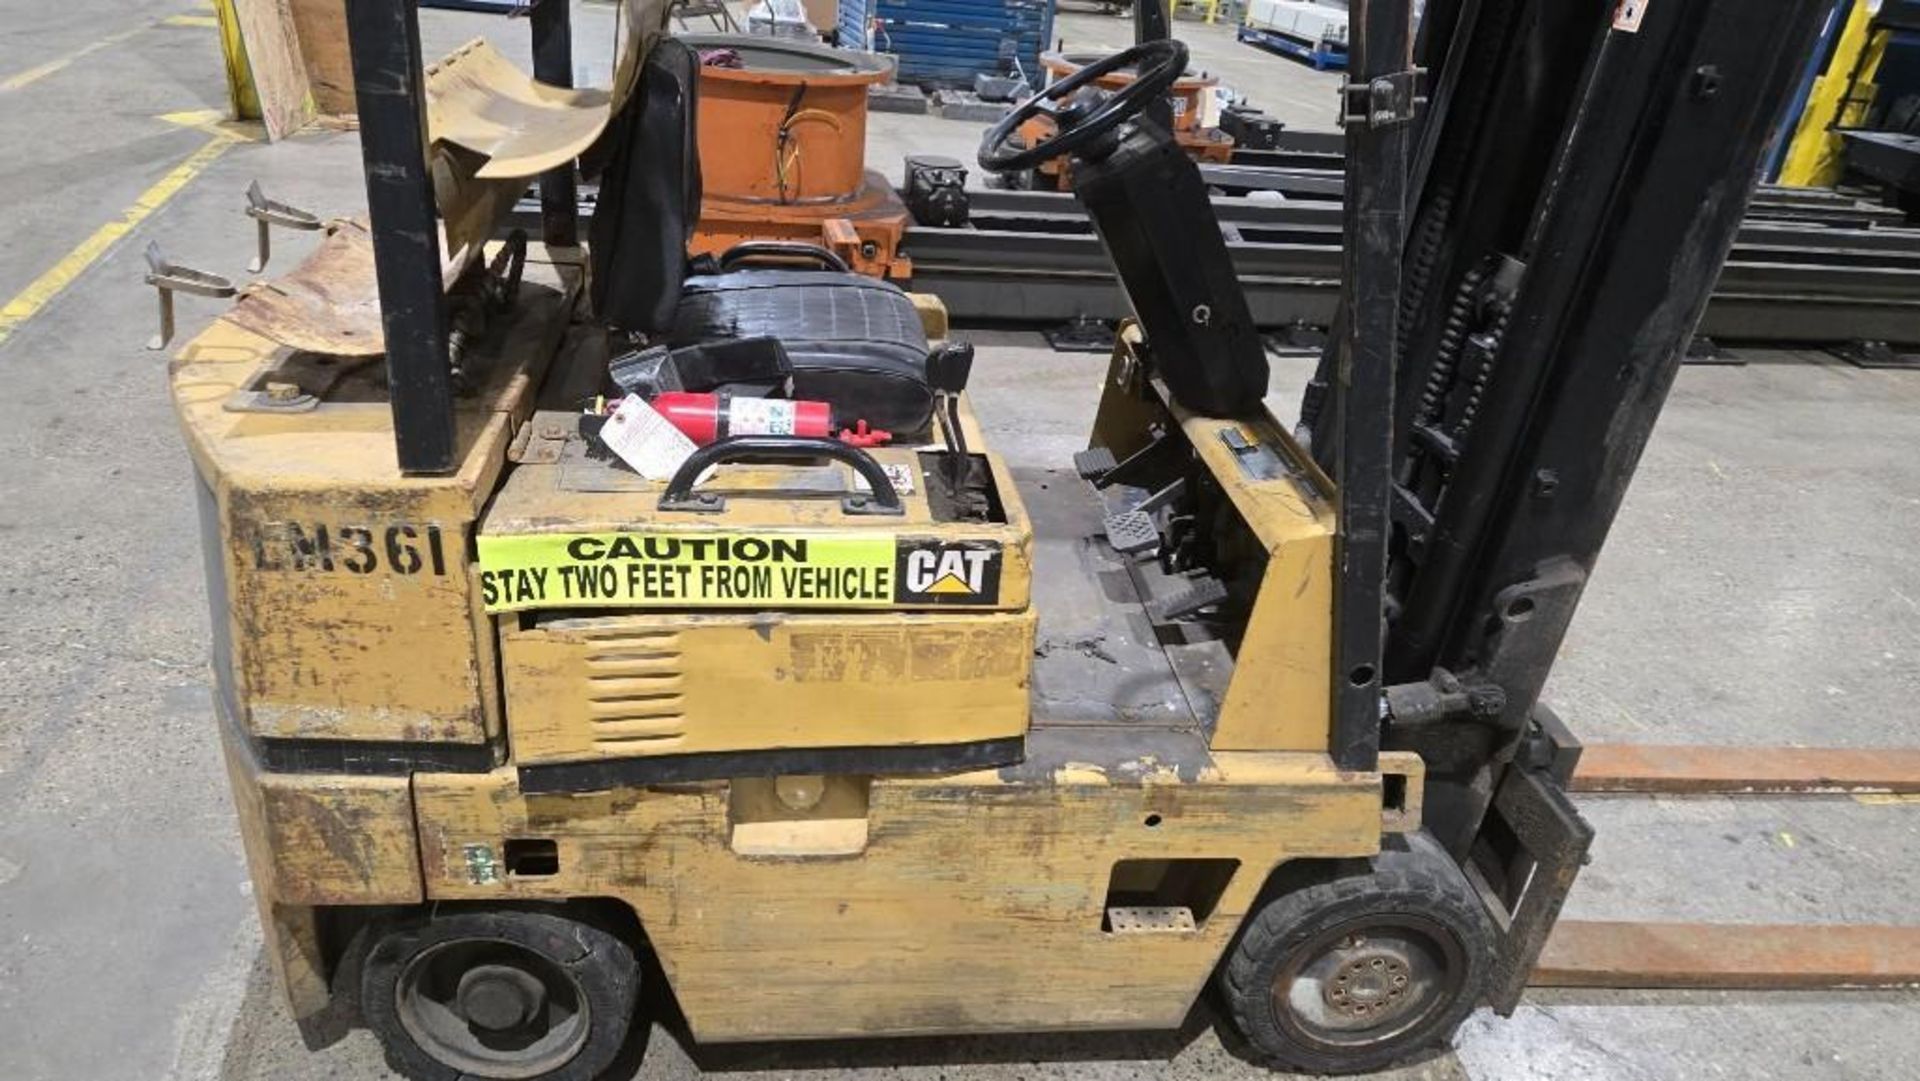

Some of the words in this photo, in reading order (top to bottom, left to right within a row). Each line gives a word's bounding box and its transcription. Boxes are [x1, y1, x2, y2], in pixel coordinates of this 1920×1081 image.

[567, 537, 807, 562] CAUTION
[481, 567, 548, 605] STAY
[558, 564, 617, 599] TWO
[627, 563, 691, 598] FEET
[701, 564, 772, 599] FROM
[781, 566, 889, 600] VEHICLE
[906, 549, 991, 593] CAT
